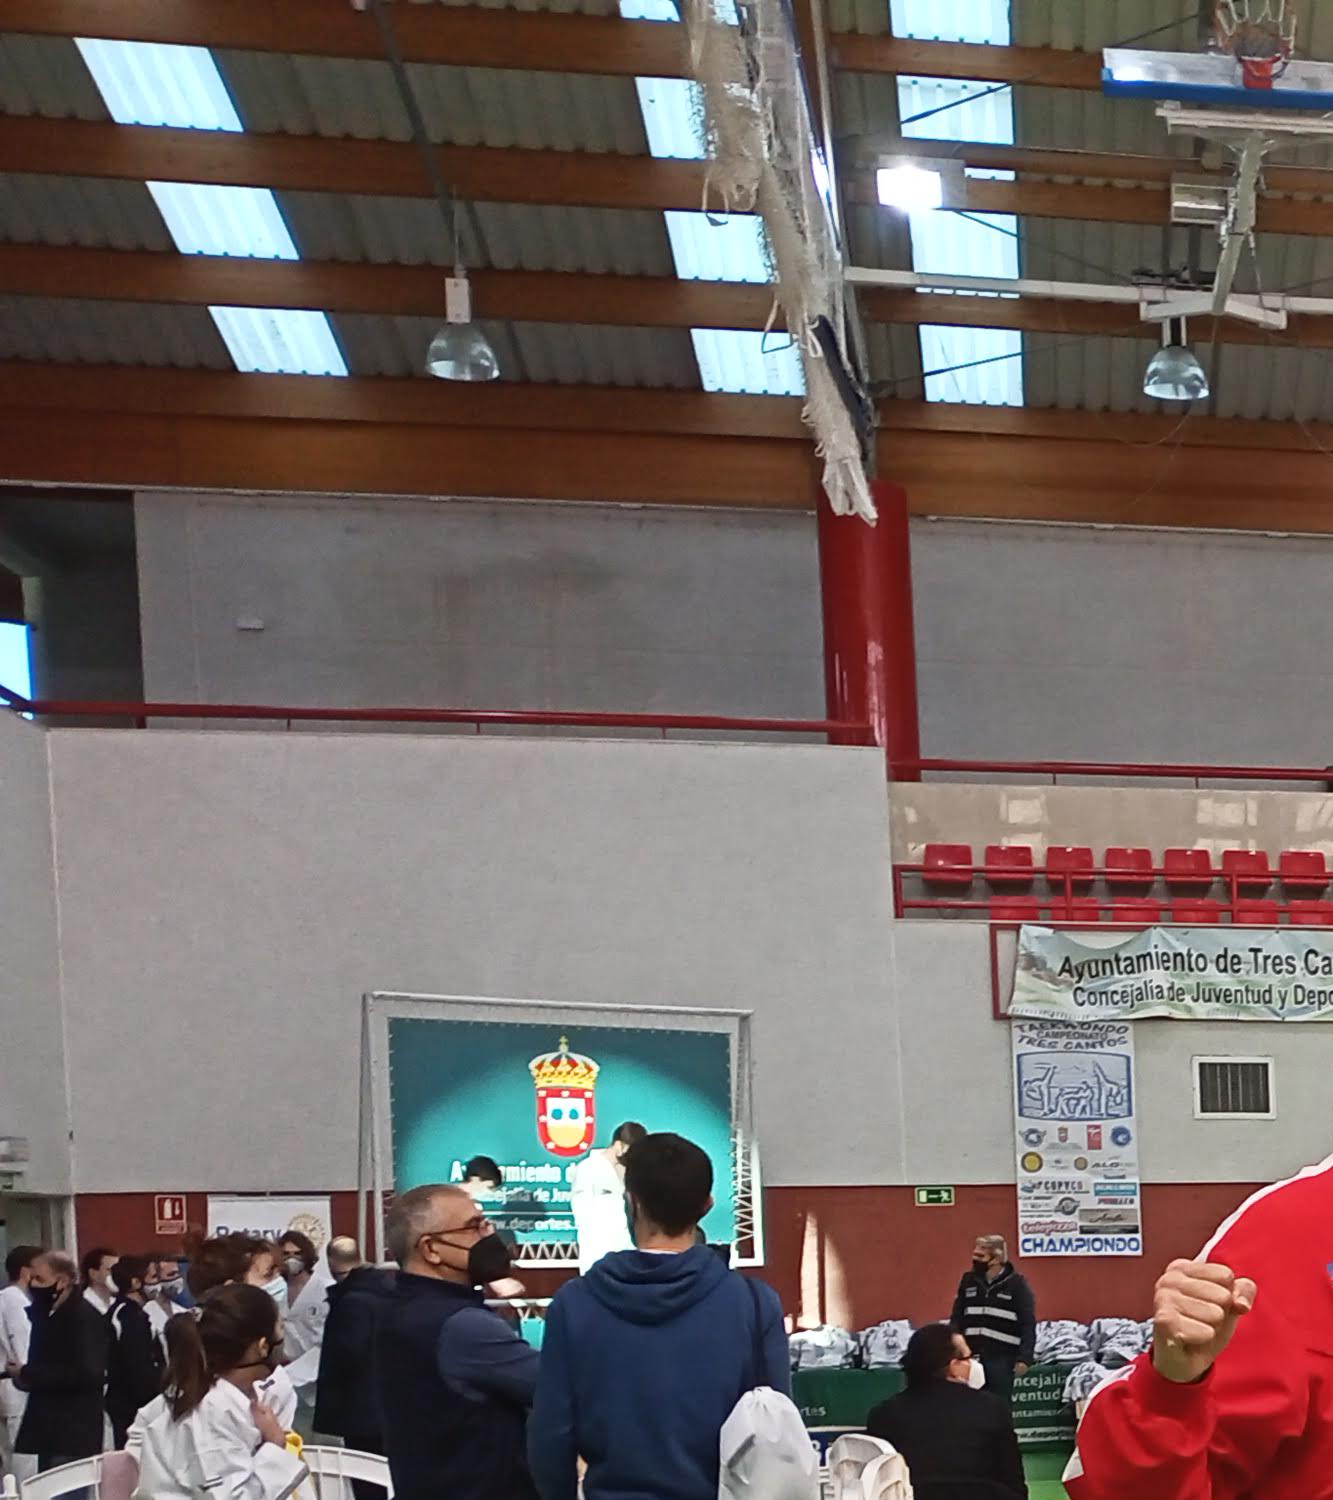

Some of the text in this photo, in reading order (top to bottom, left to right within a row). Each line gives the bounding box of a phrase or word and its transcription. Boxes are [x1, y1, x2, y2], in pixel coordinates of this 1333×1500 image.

[1058, 944, 1209, 984] Ayuntamiento
[1215, 948, 1242, 974] de
[1247, 947, 1297, 975] Tres
[1072, 979, 1165, 1009] Concejalía
[1167, 982, 1186, 1004] de
[1190, 981, 1274, 1005] Juventud
[1277, 990, 1288, 1011] y
[1014, 1021, 1129, 1034] TAEKWONDO
[1037, 1031, 1108, 1040] CAMPEONATO
[1018, 1034, 1128, 1050] TRES CANTOS
[1021, 1237, 1140, 1253] CHAMPIONDO
[1011, 1387, 1061, 1402] ventud
